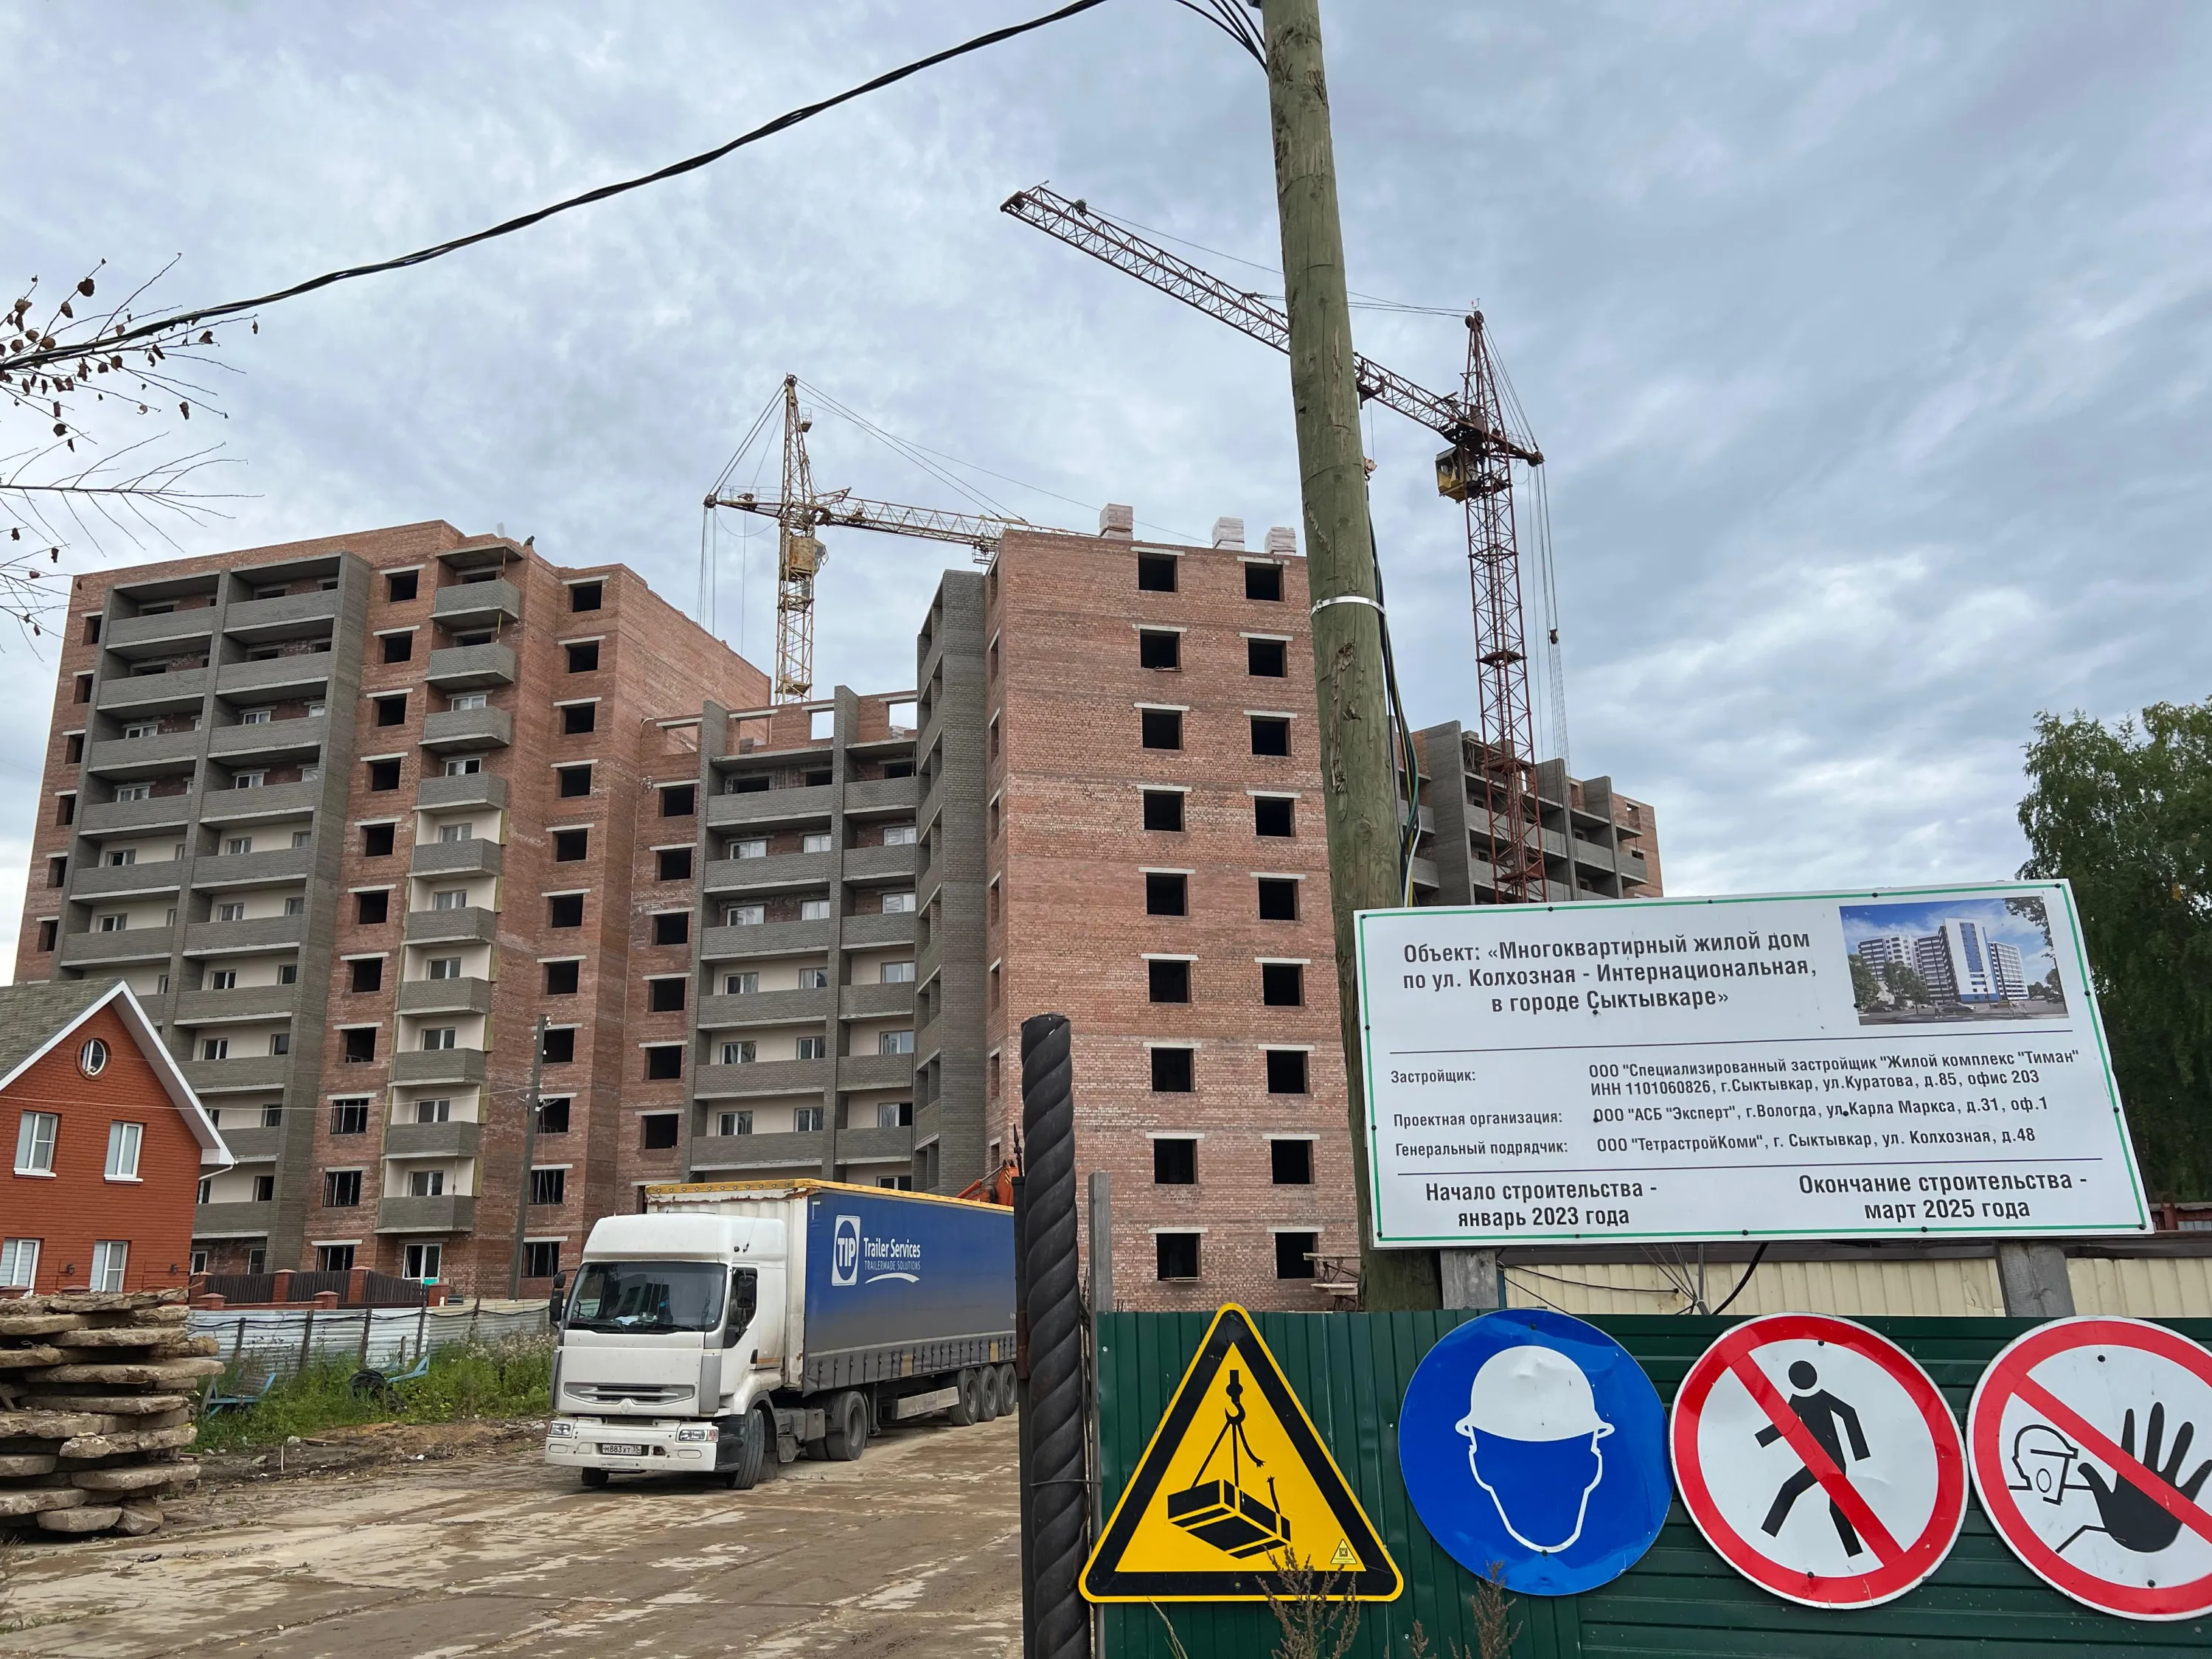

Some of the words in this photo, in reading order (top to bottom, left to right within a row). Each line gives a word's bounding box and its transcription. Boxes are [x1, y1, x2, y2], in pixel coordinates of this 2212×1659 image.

[1404, 943, 1481, 963] Объект:
[1488, 934, 1688, 961] «Многоквартирный
[1692, 930, 1761, 953] жилой
[1767, 932, 1810, 952] дом
[1403, 974, 1426, 989] по
[1431, 973, 1461, 992] ул.
[1468, 968, 1576, 987] Колхозная
[1596, 955, 1816, 985] Интернациональная,
[1491, 998, 1503, 1012] в
[1509, 995, 1580, 1015] городе
[1586, 990, 1728, 1012] Сыктывкаре»
[1589, 1063, 1619, 1078] ООО
[1622, 1058, 1787, 1078] "Специализированный
[1790, 1056, 1878, 1074] застройщик
[1879, 1053, 1938, 1069] "Жилой
[1941, 1054, 2015, 1068] комплекс
[2017, 1049, 2079, 1064] "Тиман"
[1391, 1068, 1476, 1085] Застройщик:
[1590, 1082, 1621, 1096] ИНН
[1625, 1079, 1717, 1096] 1101060826,
[1967, 1071, 2008, 1088] офис
[2011, 1069, 2039, 1084] 203
[1394, 1113, 1466, 1130] Проектная
[1470, 1113, 1562, 1128] организация:
[1593, 1107, 1624, 1124] ООО
[1627, 1107, 1663, 1121] "АСБ
[1665, 1105, 1741, 1122] "Эксперт",
[1825, 1101, 1894, 1119] улКарла
[1897, 1099, 1962, 1117] Маркса,
[1395, 1140, 1486, 1159] Генеральный
[1489, 1142, 1568, 1157] подрядчик:
[1596, 1138, 1628, 1152] ООО
[1631, 1134, 1769, 1154] "ТетрастройКоми",
[1788, 1133, 1878, 1149] Сыктывкар,
[1881, 1133, 1905, 1148] ул.
[1908, 1130, 1997, 1145] Колхозная,
[1425, 1183, 1496, 1201] Начало
[1502, 1182, 1644, 1204] строительства
[1798, 1175, 1912, 1194] Окончание
[1918, 1174, 2073, 1196] строительства
[1458, 1211, 1527, 1231] январь
[1531, 1206, 1579, 1226] 2023
[1585, 1208, 1630, 1227] года
[1864, 1203, 1917, 1223] март
[1922, 1198, 1975, 1219] 2025
[1981, 1201, 2031, 1220] года
[838, 1237, 856, 1267] TIP
[863, 1237, 889, 1258] Trailer
[890, 1238, 921, 1258] Services
